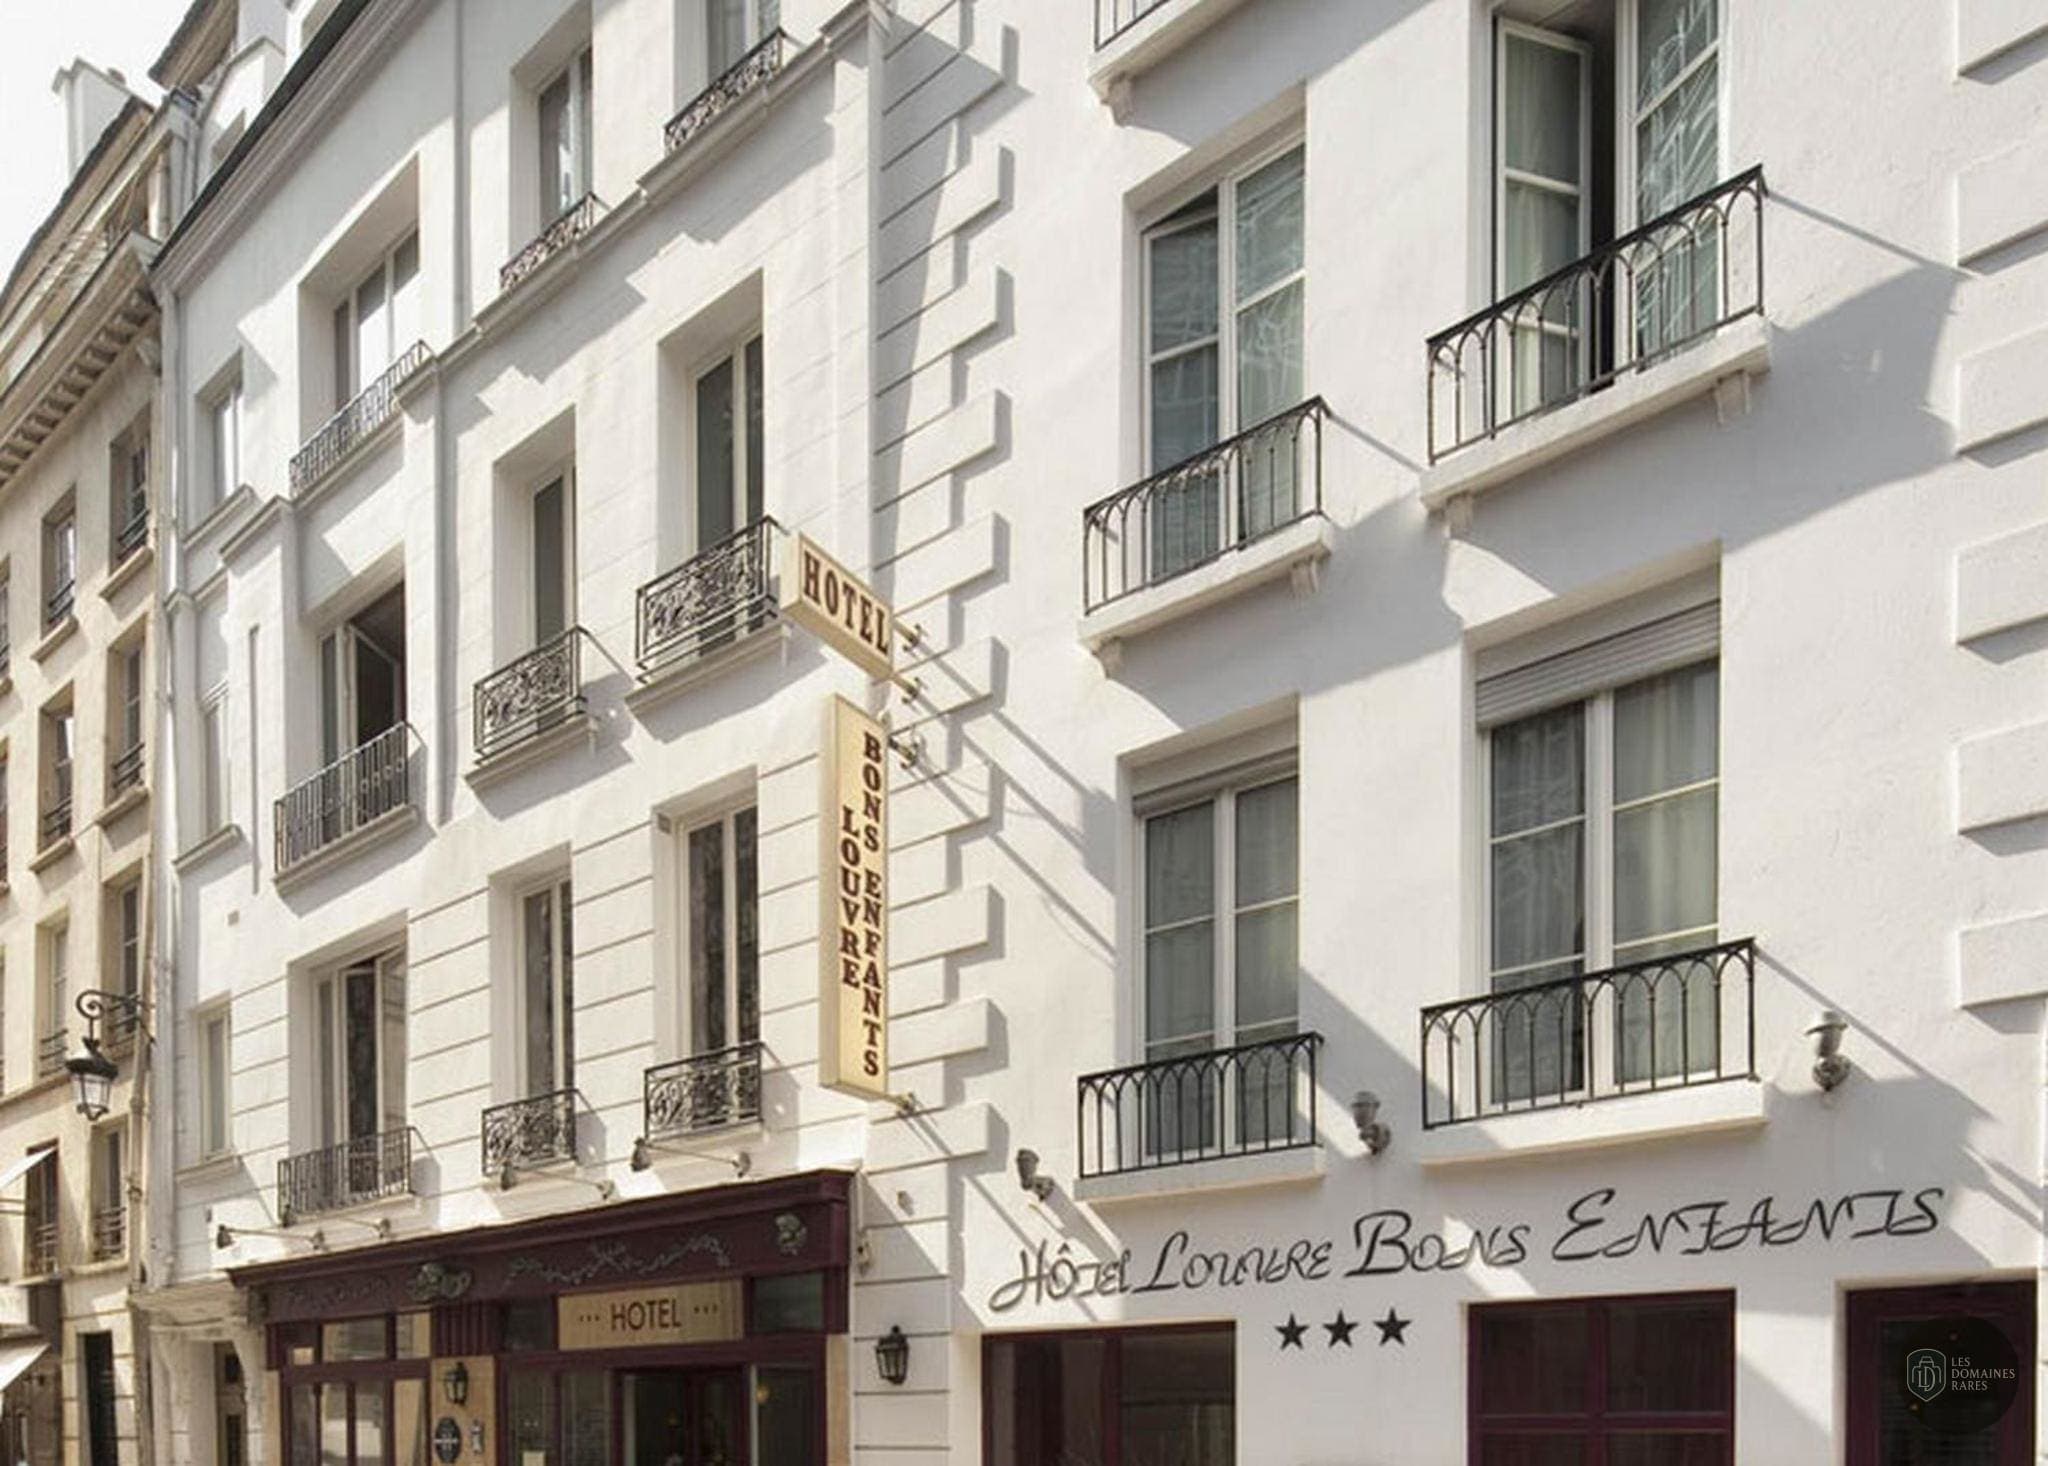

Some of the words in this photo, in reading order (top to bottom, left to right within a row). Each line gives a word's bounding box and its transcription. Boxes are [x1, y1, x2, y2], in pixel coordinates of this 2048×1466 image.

[803, 550, 889, 656] HOTEL
[863, 732, 881, 853] BONS
[841, 805, 860, 987] LOUVRE
[863, 868, 881, 1077] ENFANTS
[610, 1299, 683, 1331] HOTEL
